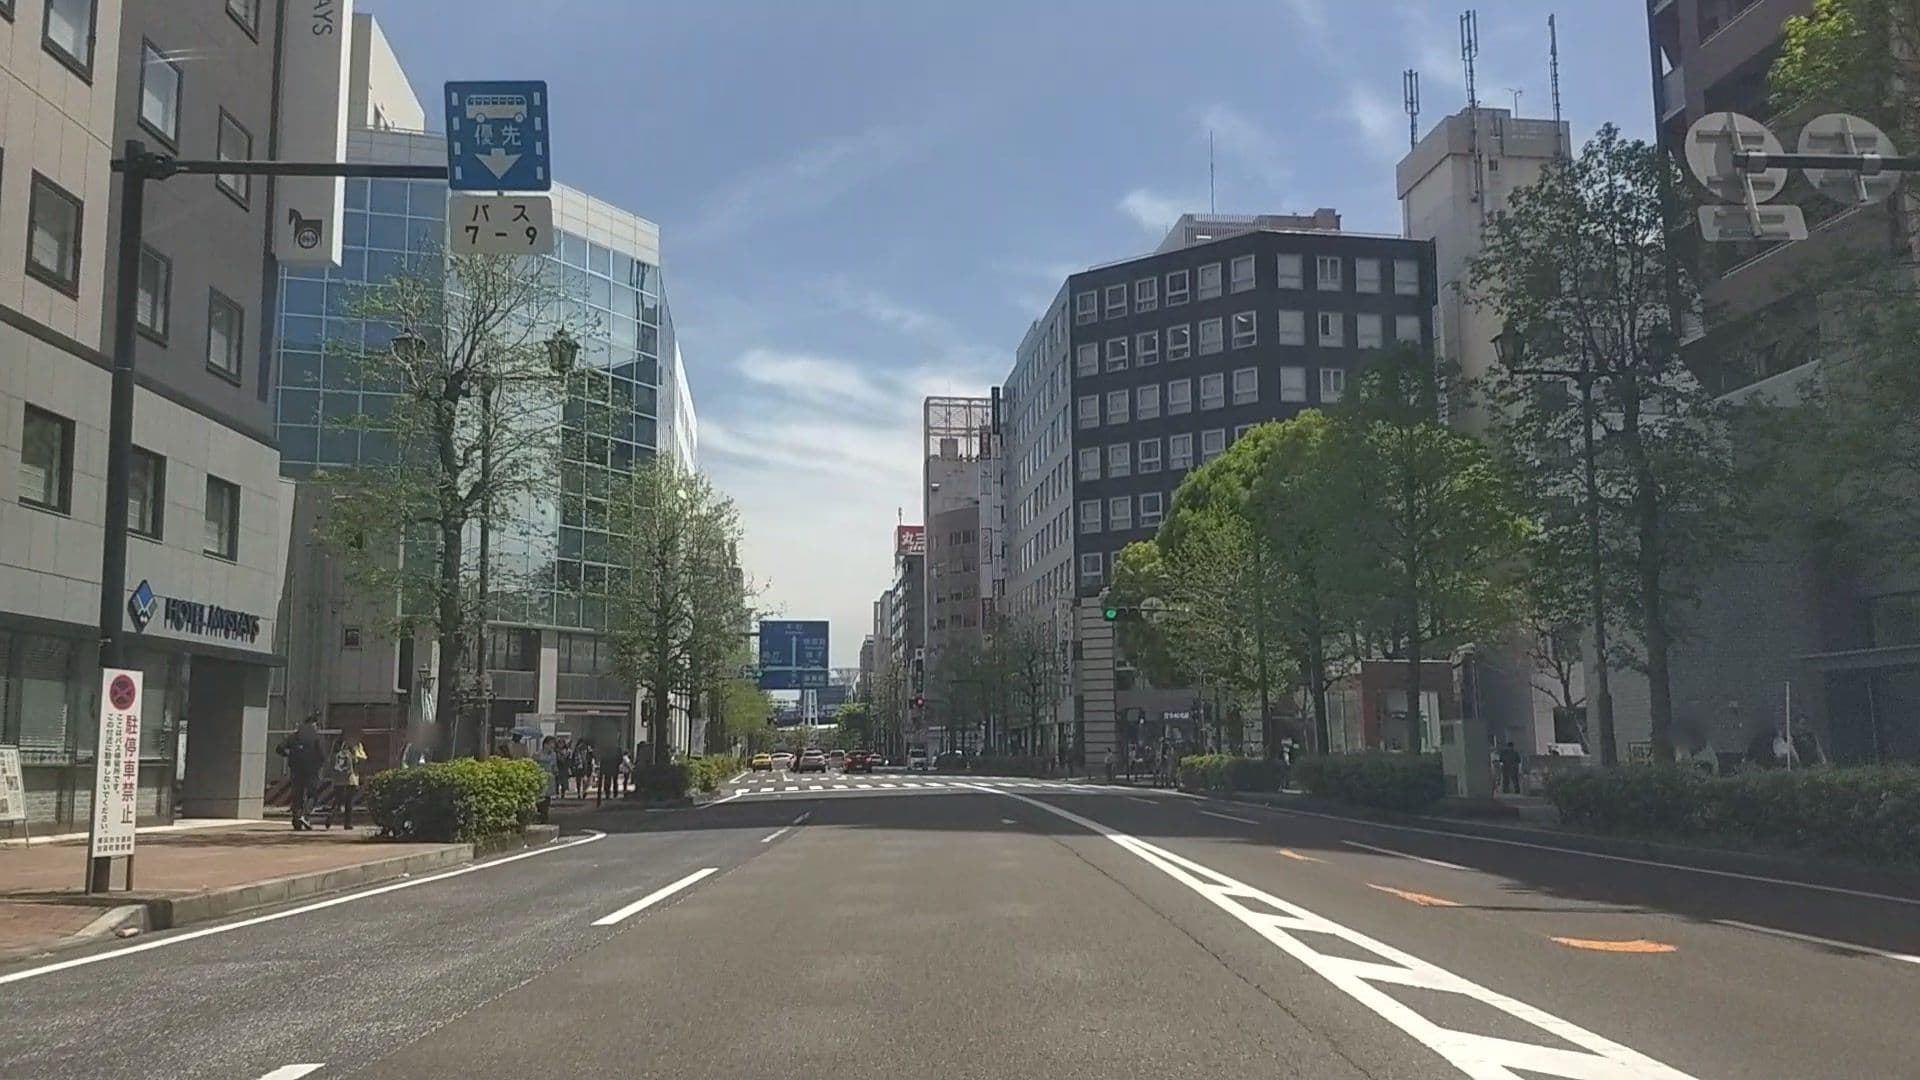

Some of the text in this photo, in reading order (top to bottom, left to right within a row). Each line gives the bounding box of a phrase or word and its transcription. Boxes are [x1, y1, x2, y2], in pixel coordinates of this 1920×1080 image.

[474, 124, 521, 146] 優先
[472, 205, 530, 222] バス
[164, 597, 260, 640] HOTEL MYSTAYS
[120, 715, 138, 824] 駐停車禁止
